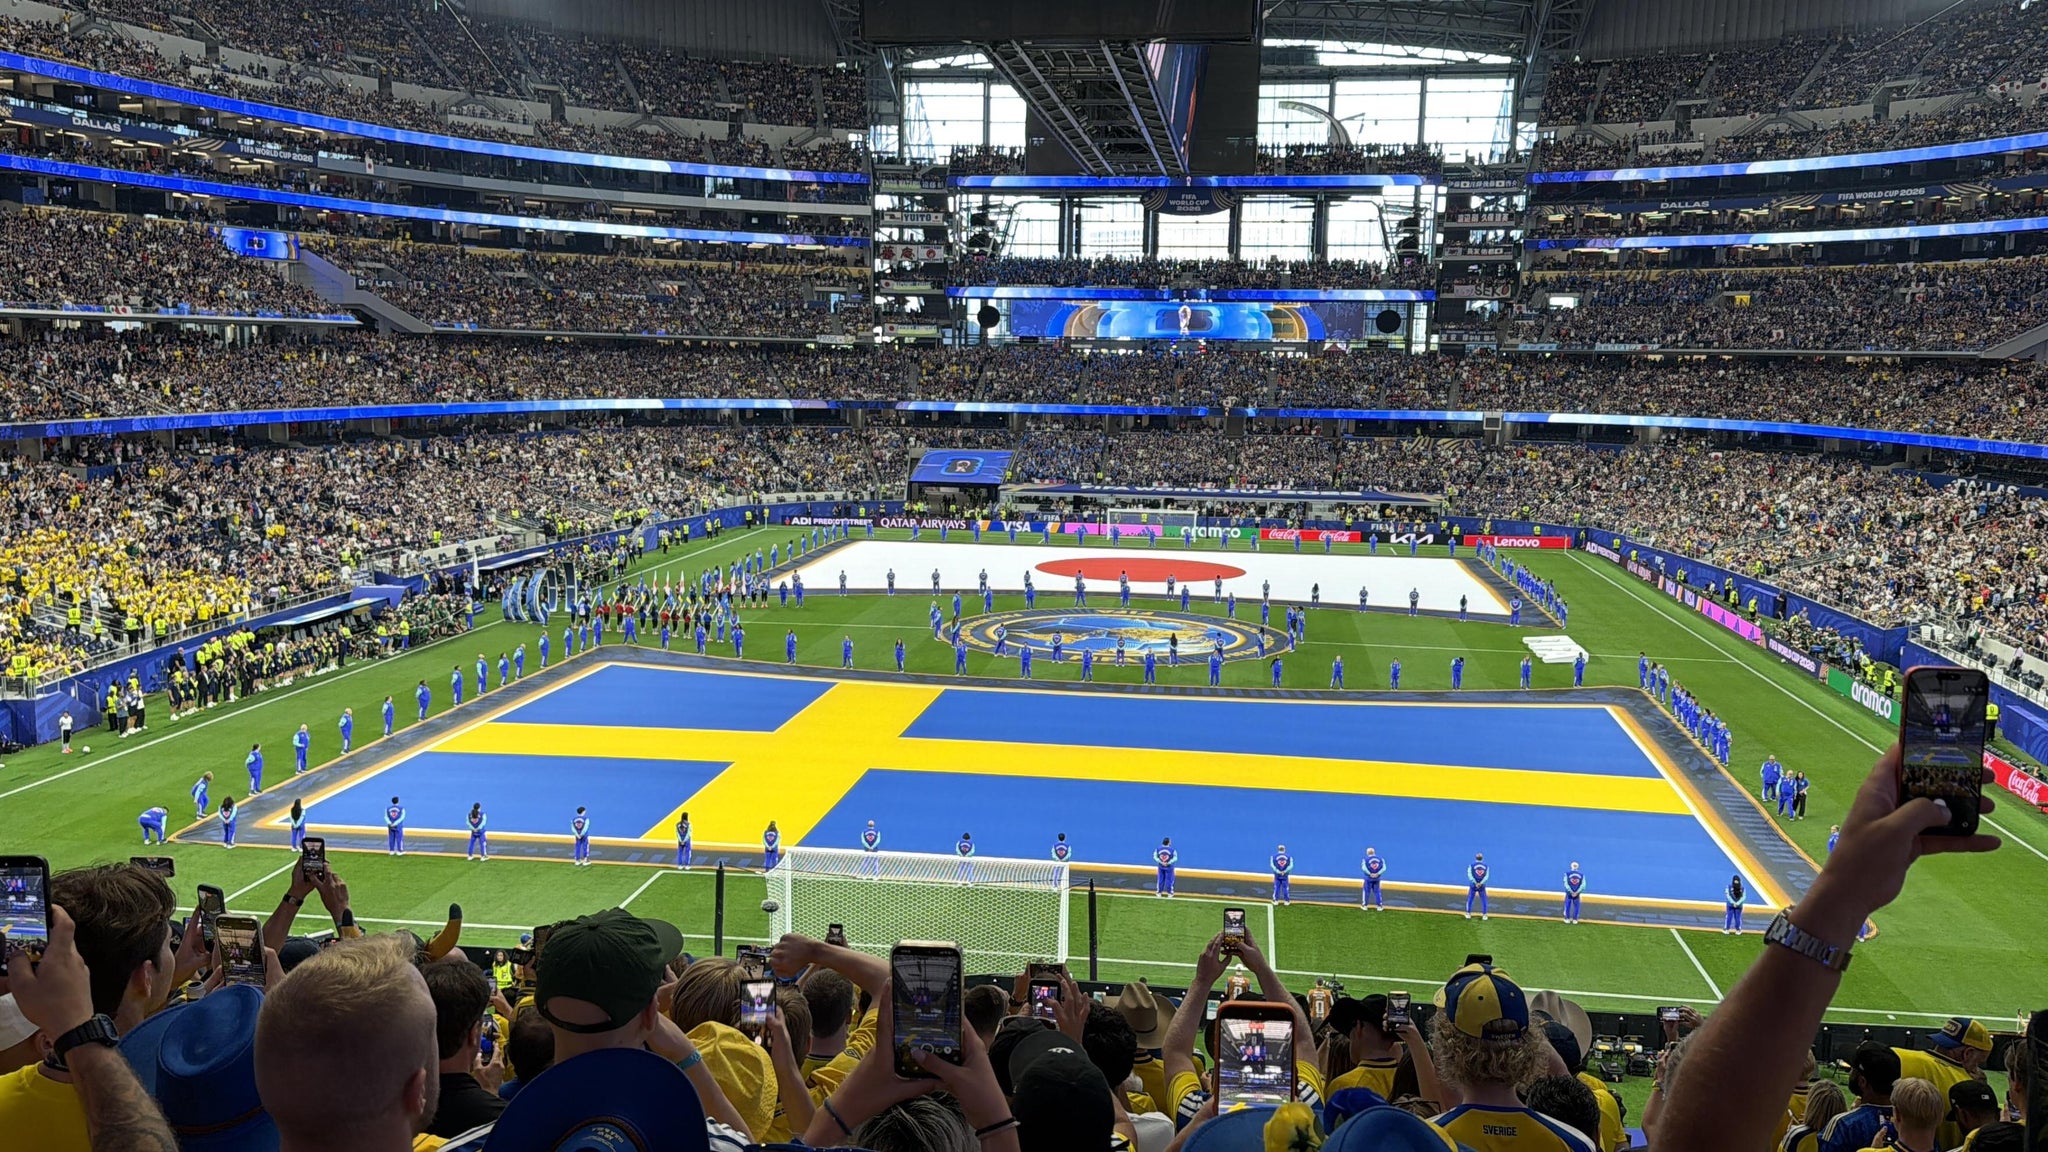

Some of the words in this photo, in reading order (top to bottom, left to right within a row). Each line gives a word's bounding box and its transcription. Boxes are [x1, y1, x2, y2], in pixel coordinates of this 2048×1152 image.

[72, 116, 121, 132] DALLAS
[240, 144, 255, 154] FIFA
[255, 147, 278, 157] WORLD
[279, 151, 292, 159] CUP
[292, 153, 314, 162] 2026
[1855, 190, 1883, 199] WORLD
[1884, 189, 1899, 197] CUP
[1900, 187, 1926, 197] 2026
[1660, 200, 1710, 209] DALLAS
[903, 213, 931, 222] YUITO
[791, 517, 812, 525] ADI
[880, 517, 917, 528] QATAR
[920, 518, 967, 529] AIRWAYS
[1001, 520, 1031, 532] VISA
[1181, 526, 1241, 538] aramco
[1494, 536, 1540, 548] Lenovo
[1851, 681, 1892, 719] aramco
[2008, 769, 2042, 806] Coca-Cola
[1482, 1124, 1518, 1136] SVERIGE
